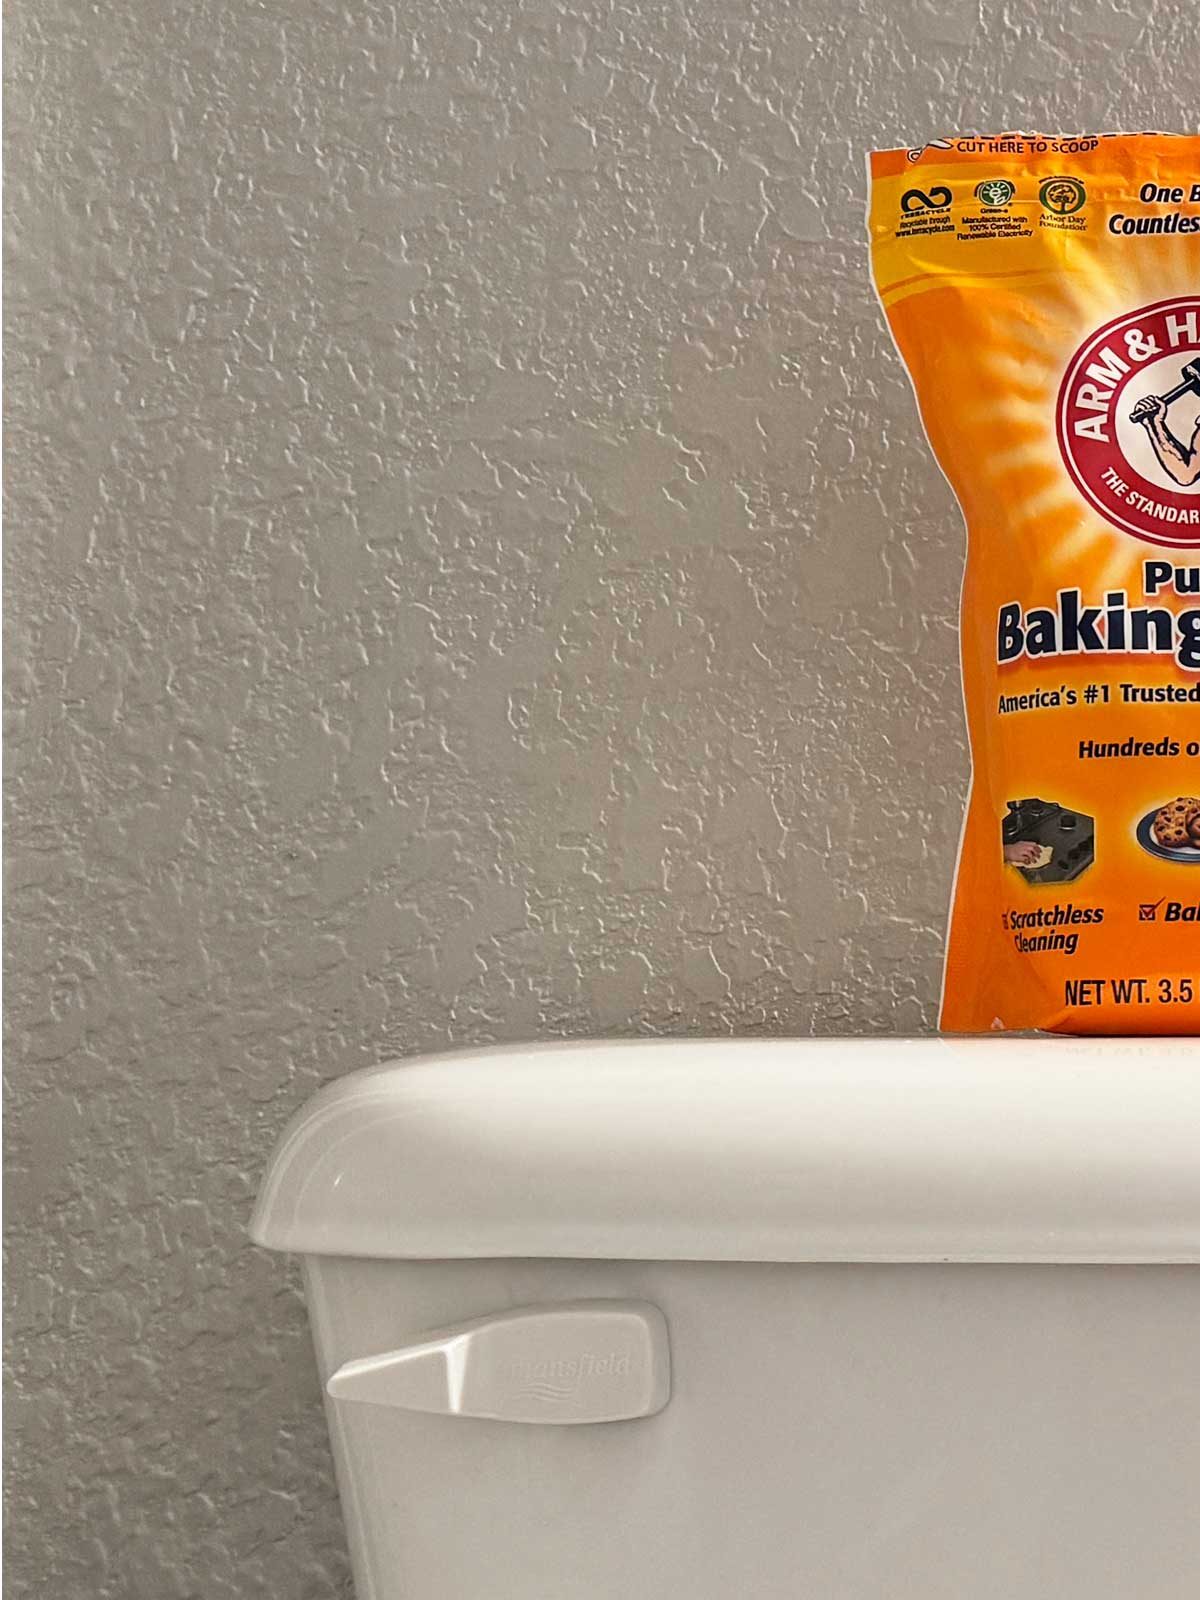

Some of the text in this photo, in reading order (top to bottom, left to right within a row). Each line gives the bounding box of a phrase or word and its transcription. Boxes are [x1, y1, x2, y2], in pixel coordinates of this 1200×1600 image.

[957, 139, 1099, 154] CUT HERE TO SCOOP
[1140, 183, 1186, 203] One
[962, 216, 1011, 225] Manufactured
[990, 223, 1021, 231] Certified
[1039, 213, 1087, 225] Arbor Day
[1039, 220, 1087, 231] Foundation
[957, 231, 997, 241] Renewable
[1074, 346, 1132, 443] ARM
[1123, 328, 1164, 362] &
[1101, 466, 1130, 497] THE
[998, 685, 1077, 714] America's
[1083, 684, 1110, 704] #1
[1078, 736, 1180, 759] Hundreds
[1010, 903, 1105, 930] Scratchless
[1014, 928, 1079, 955] Cleaning
[1064, 979, 1106, 1006] NET
[1110, 978, 1150, 1004] WT.
[1158, 978, 1194, 1003] 3.5
